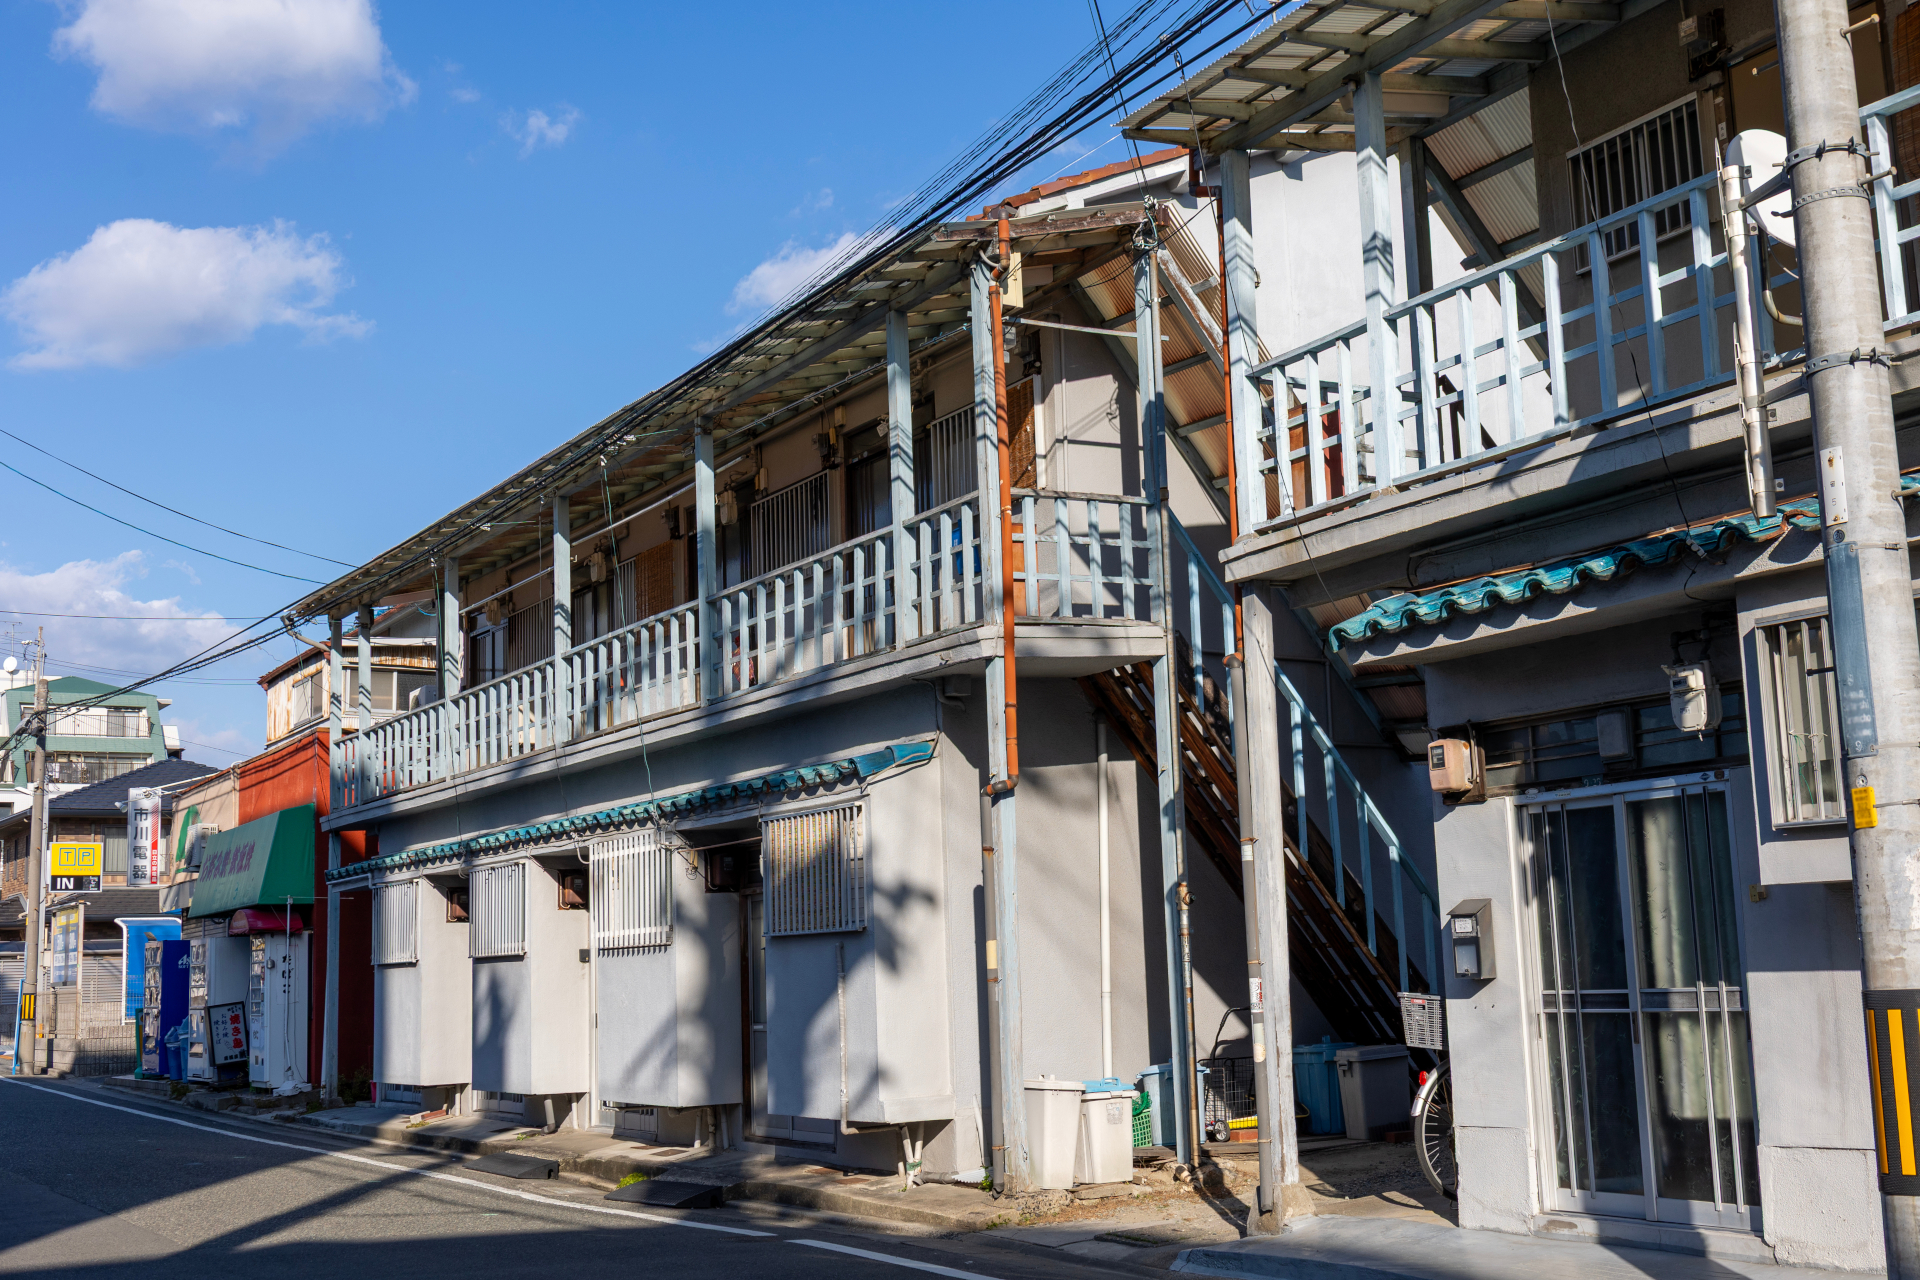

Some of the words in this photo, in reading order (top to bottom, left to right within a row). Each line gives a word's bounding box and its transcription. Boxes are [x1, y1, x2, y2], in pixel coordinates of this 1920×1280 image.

[133, 807, 149, 880] 市川電器
[56, 877, 75, 890] IN
